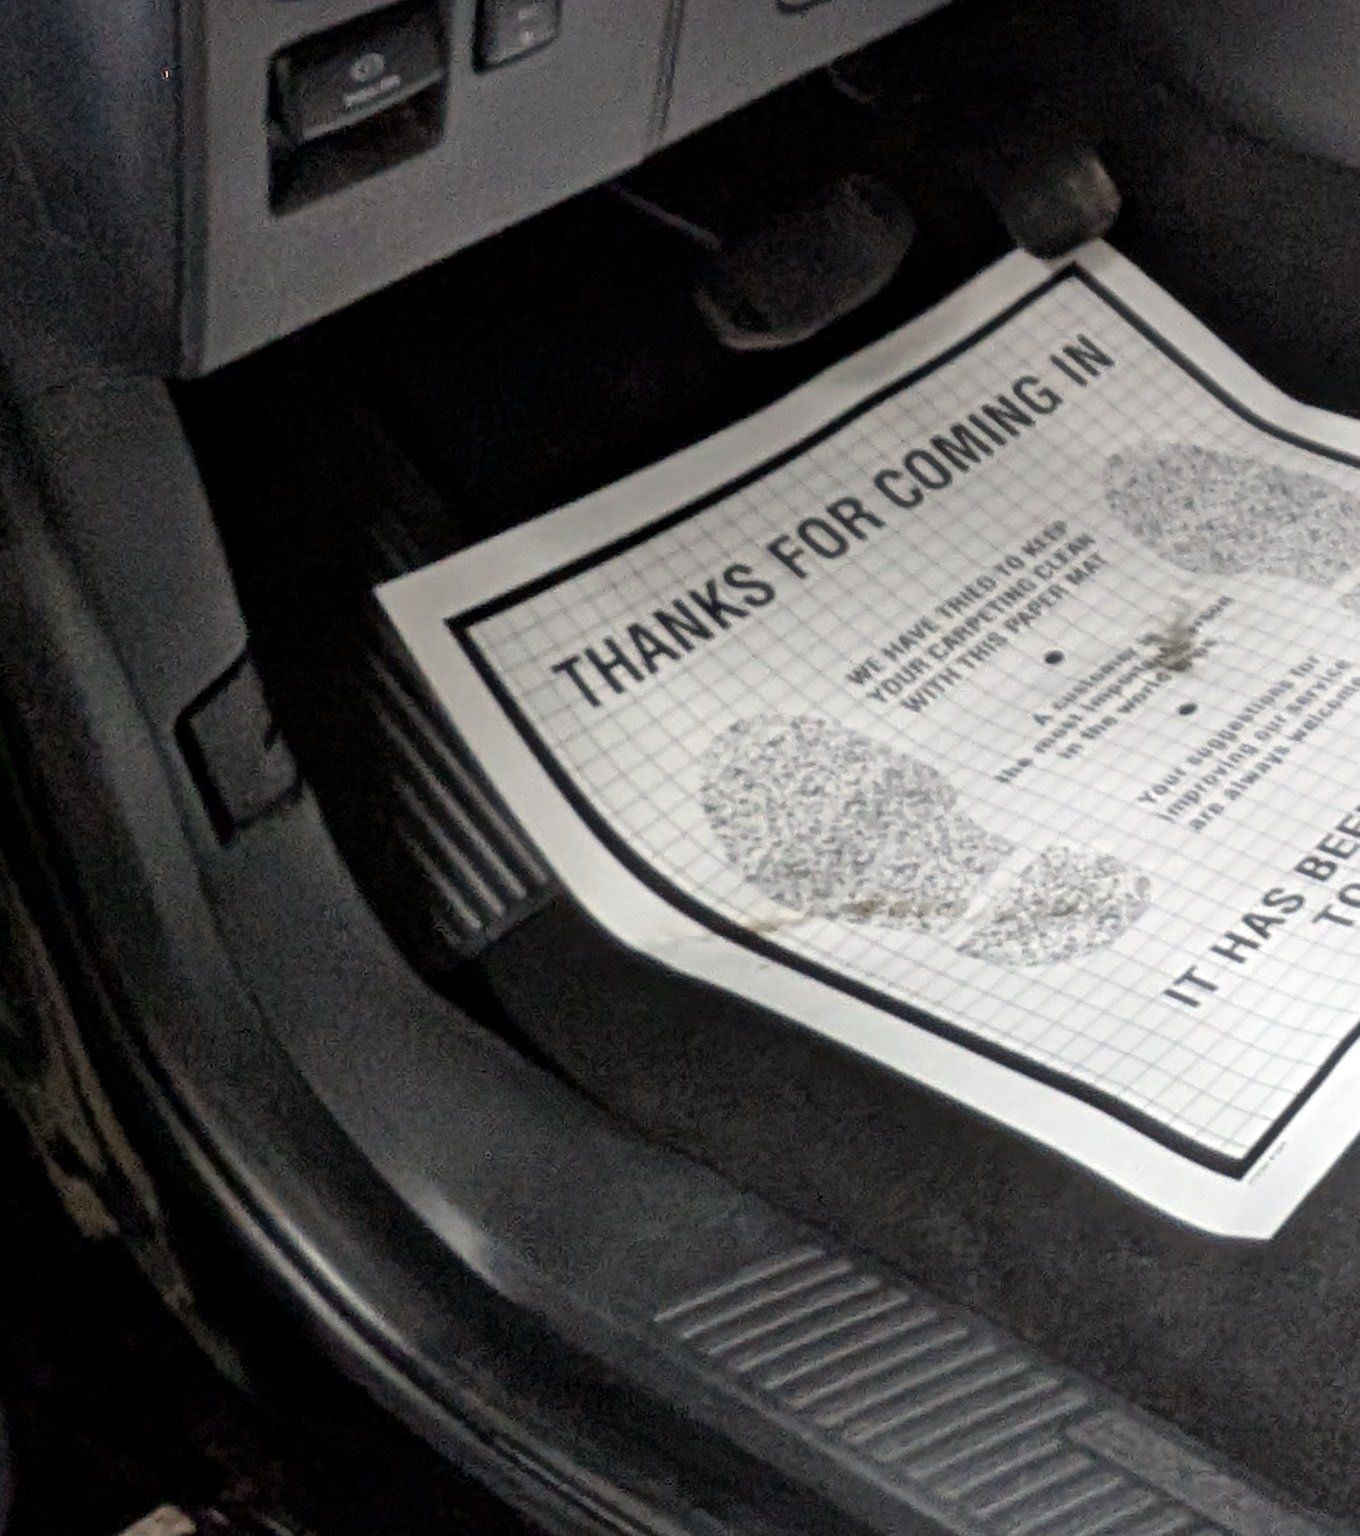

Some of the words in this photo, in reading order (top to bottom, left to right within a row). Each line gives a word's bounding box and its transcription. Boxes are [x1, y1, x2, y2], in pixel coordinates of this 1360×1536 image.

[551, 563, 776, 707] THANKS
[767, 497, 887, 579] FOR
[874, 375, 1064, 510] COMING
[1049, 333, 1116, 387] IN
[845, 655, 887, 687] WE
[880, 615, 941, 662] HAVE
[934, 574, 998, 620] TRIED
[992, 554, 1026, 577] TO
[1020, 519, 1069, 558] KEEP
[866, 656, 934, 704] YOUR
[926, 576, 1038, 661] CARPETING
[1032, 531, 1096, 582] CLEAN
[899, 665, 963, 715] WITH
[955, 631, 1010, 670] THIS
[1002, 583, 1070, 635] PAPER
[1064, 551, 1109, 586] MAT
[1033, 713, 1084, 754] most
[1181, 595, 1235, 638] erson
[1051, 646, 1137, 711] customer
[1116, 670, 1173, 714] world
[1136, 766, 1188, 805] Your
[1185, 678, 1295, 767] suggestions
[1289, 654, 1321, 678] for
[1155, 742, 1260, 824] improving
[1252, 713, 1289, 742] our
[1285, 657, 1353, 714] service
[1188, 802, 1226, 833] are
[1223, 744, 1292, 802] always
[1162, 965, 1220, 1010] IT
[1209, 886, 1308, 965] HAS
